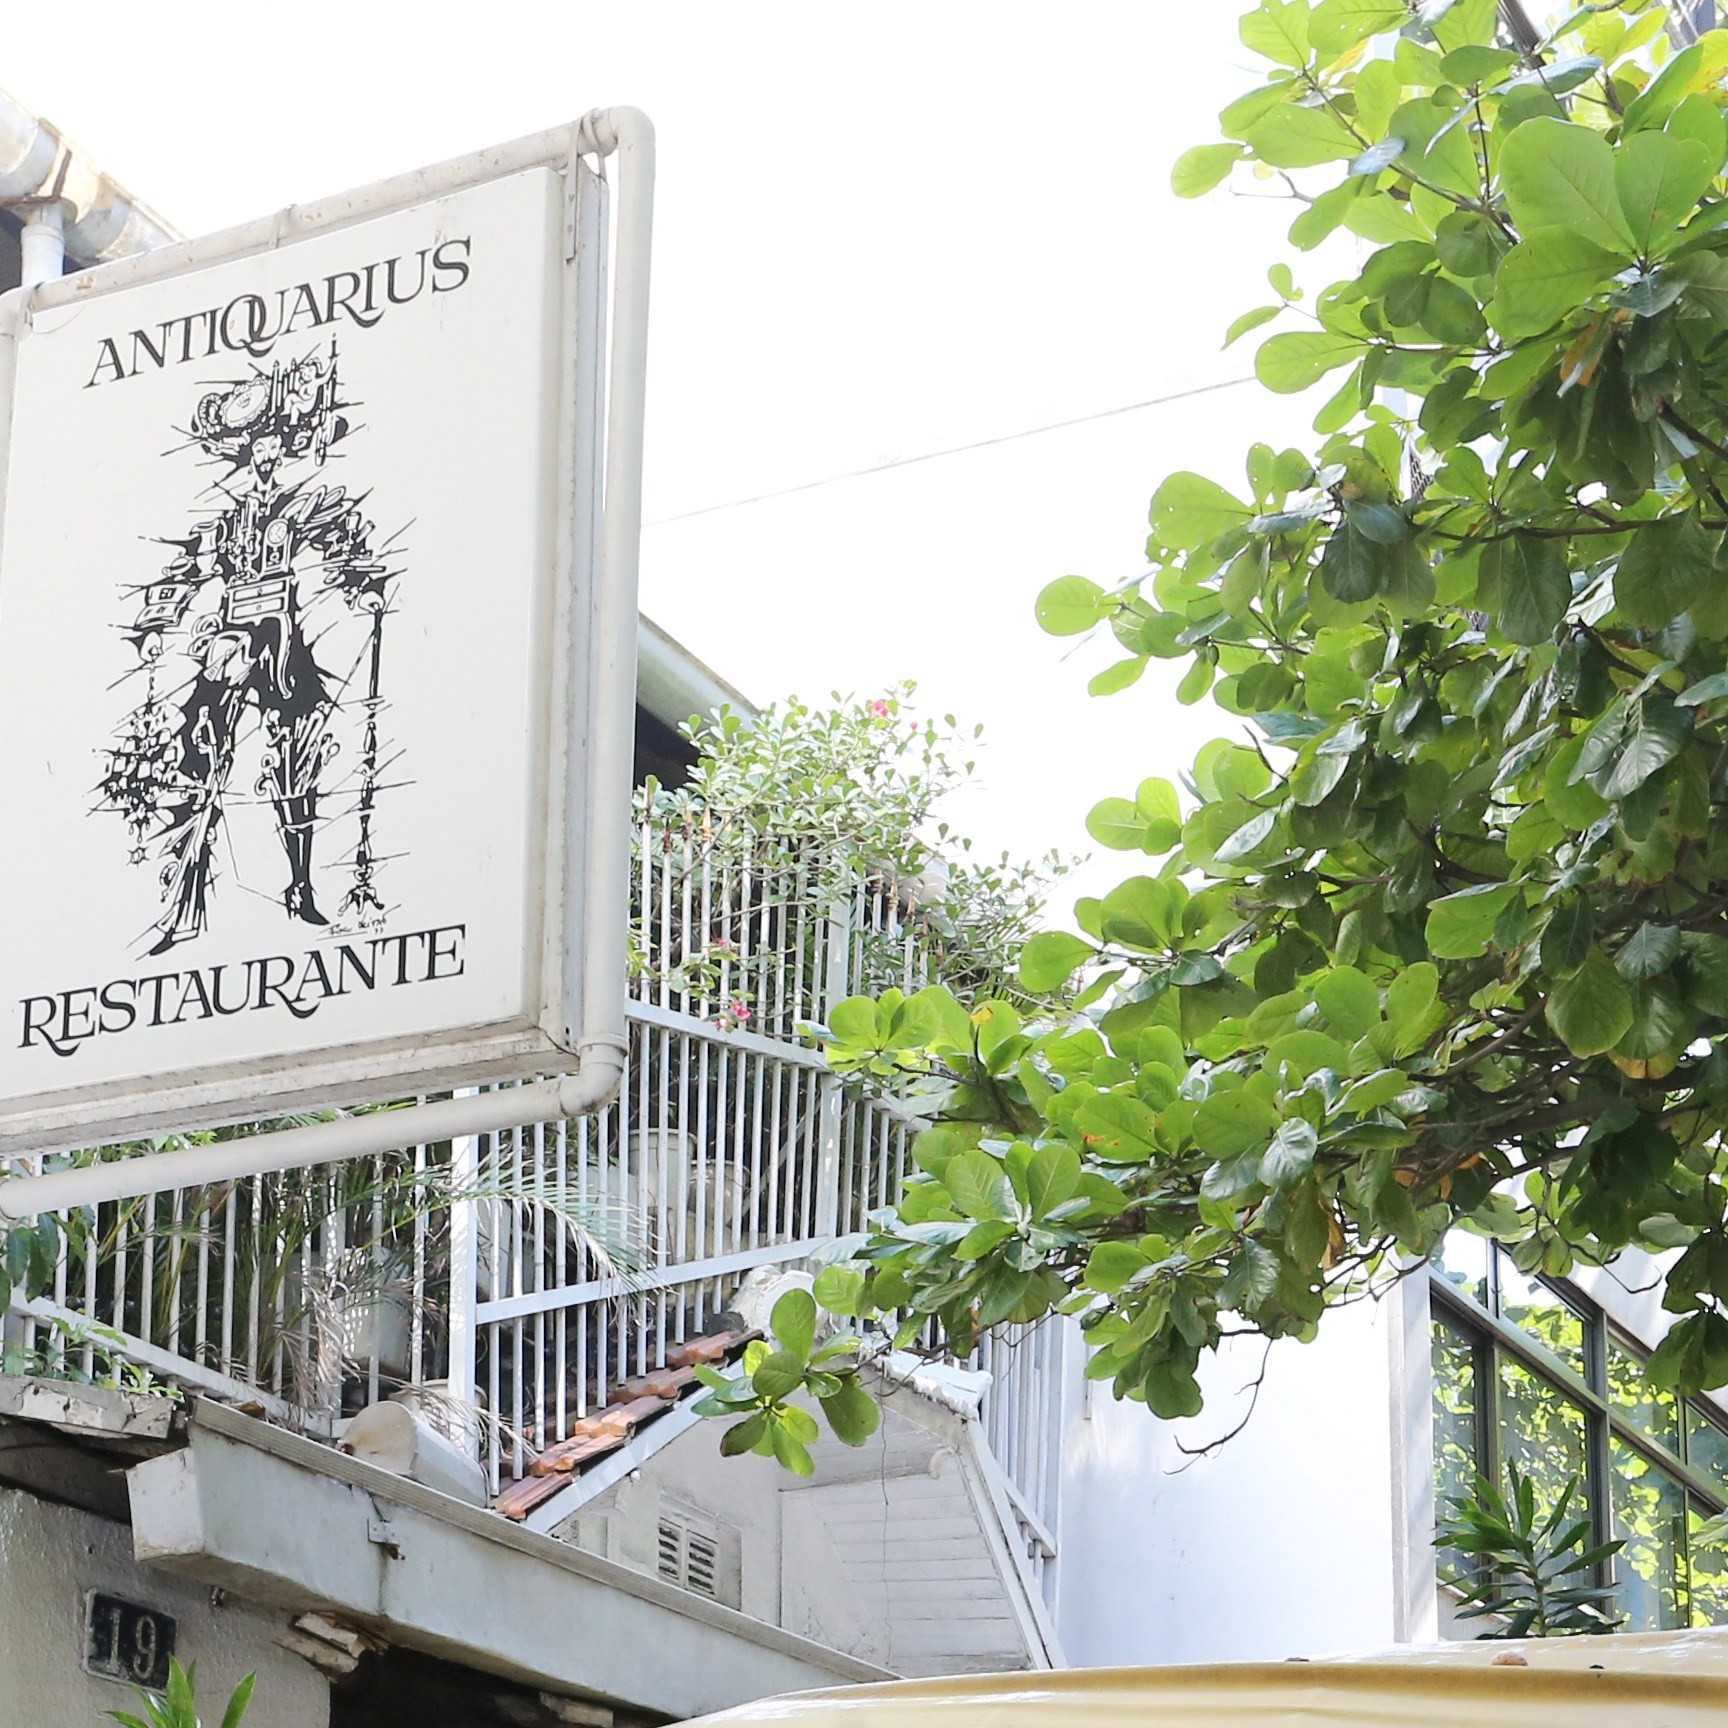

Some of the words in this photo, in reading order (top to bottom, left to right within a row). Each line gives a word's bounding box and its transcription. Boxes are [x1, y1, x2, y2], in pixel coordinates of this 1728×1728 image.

[82, 235, 472, 390] ANTIQUARIUS
[16, 923, 467, 1057] RESTAURANTE
[108, 1607, 156, 1679] 19
